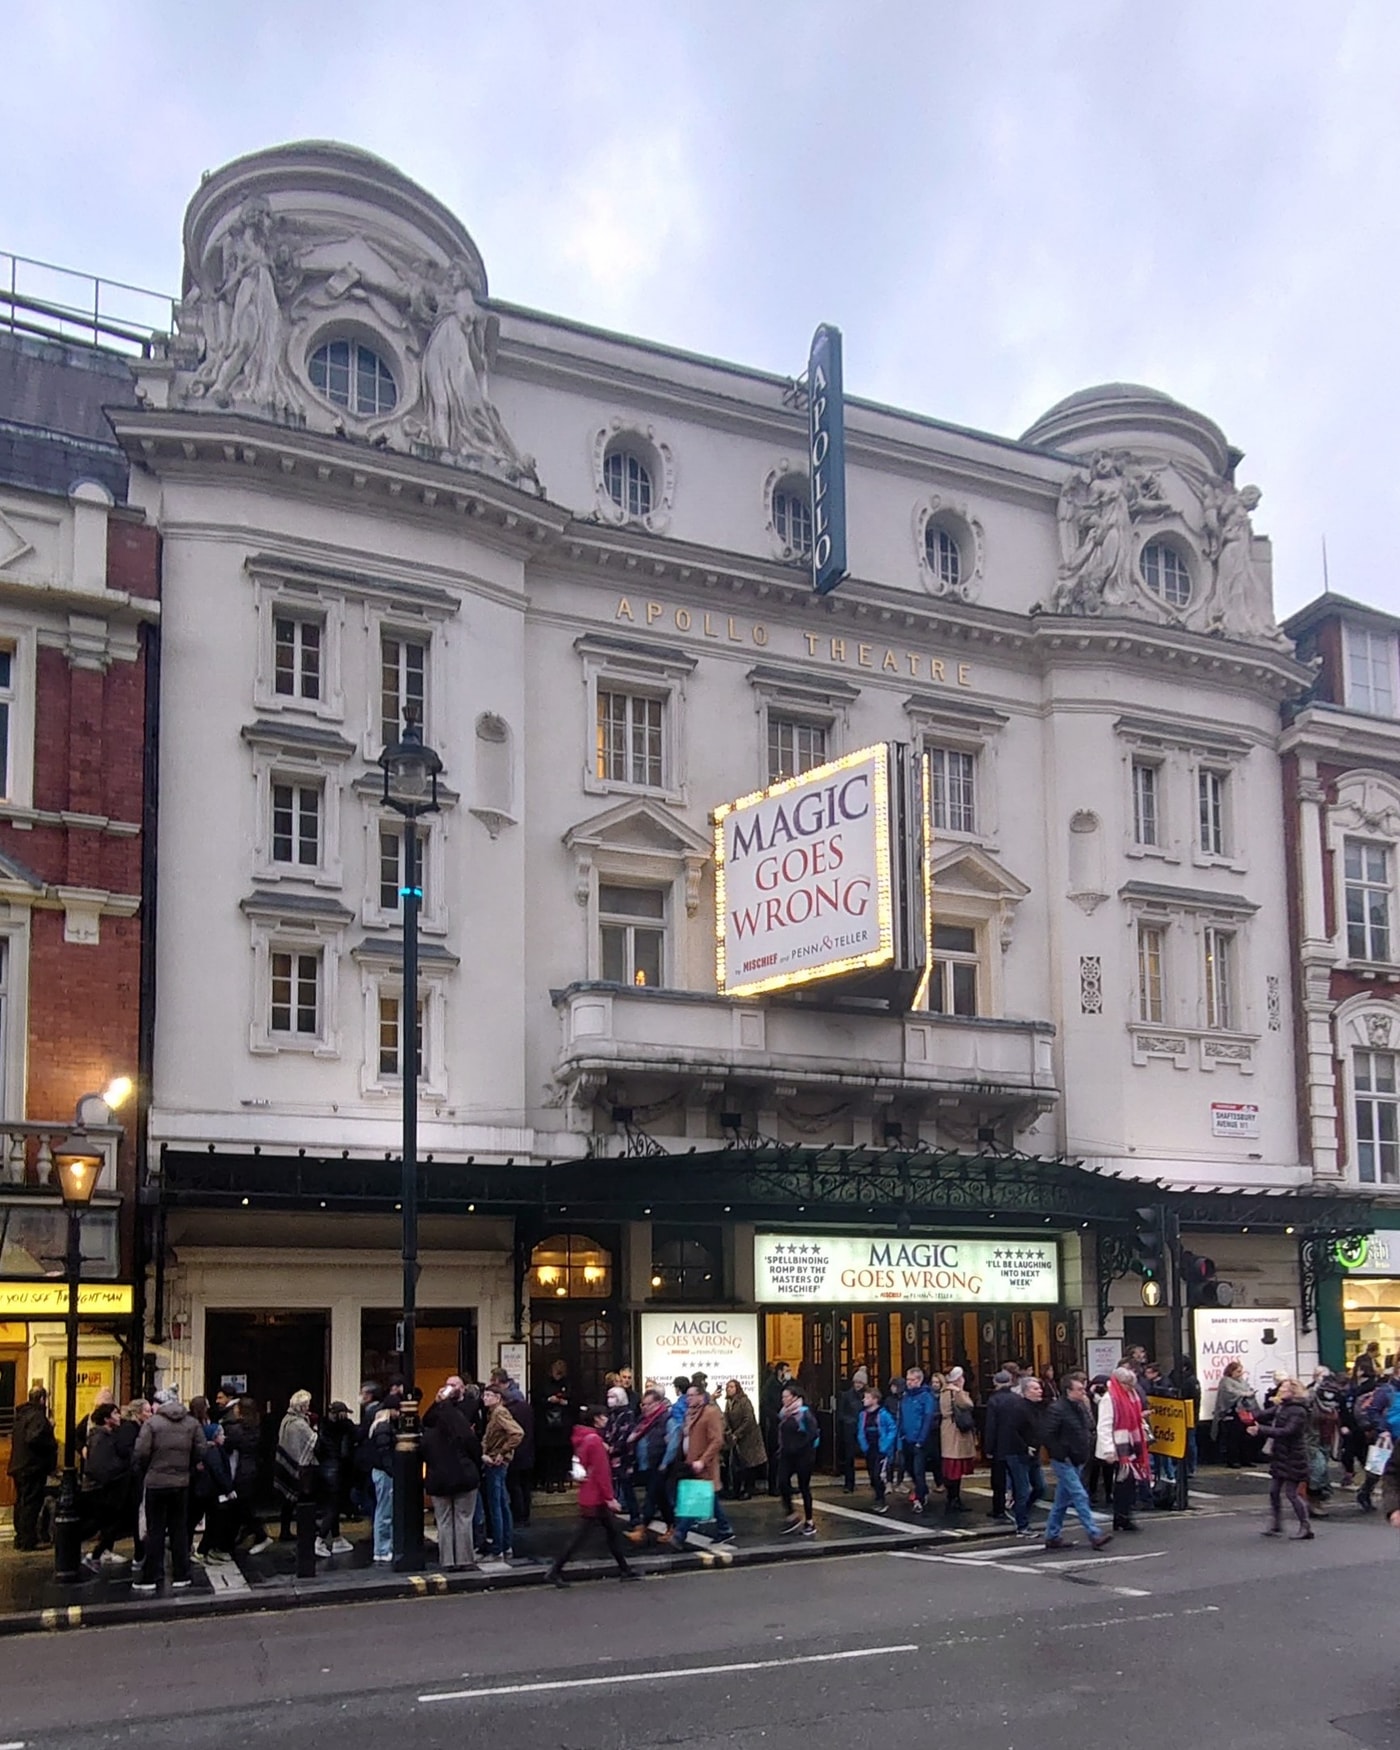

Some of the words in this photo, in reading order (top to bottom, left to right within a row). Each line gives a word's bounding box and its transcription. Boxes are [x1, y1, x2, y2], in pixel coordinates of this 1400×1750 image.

[813, 365, 831, 571] APOLLO
[616, 597, 769, 647] APOLLO
[804, 631, 972, 688] THEATRE
[729, 774, 870, 863] MAGIC
[755, 834, 844, 892] GOES
[731, 877, 871, 941] WRONG
[743, 953, 778, 973] MISCHIEF
[791, 943, 819, 959] PENN
[834, 930, 868, 948] TELLER
[868, 1242, 959, 1268] MAGIC
[1002, 1260, 1012, 1268] BE
[1013, 1260, 1052, 1269] LAUGHING
[769, 1266, 795, 1274] ROMP
[797, 1266, 808, 1274] BY
[810, 1266, 826, 1274] THE
[772, 1275, 812, 1284] MASTERS
[813, 1276, 825, 1284] OF
[1000, 1269, 1019, 1277] INTO
[840, 1269, 895, 1288] GOES
[901, 1270, 983, 1295] WRONG
[672, 1320, 728, 1335] MAGIC
[655, 1335, 689, 1347] GOES
[693, 1335, 742, 1349] WRONG
[1202, 1339, 1249, 1355] MAGIC
[1154, 1425, 1176, 1442] Ends
